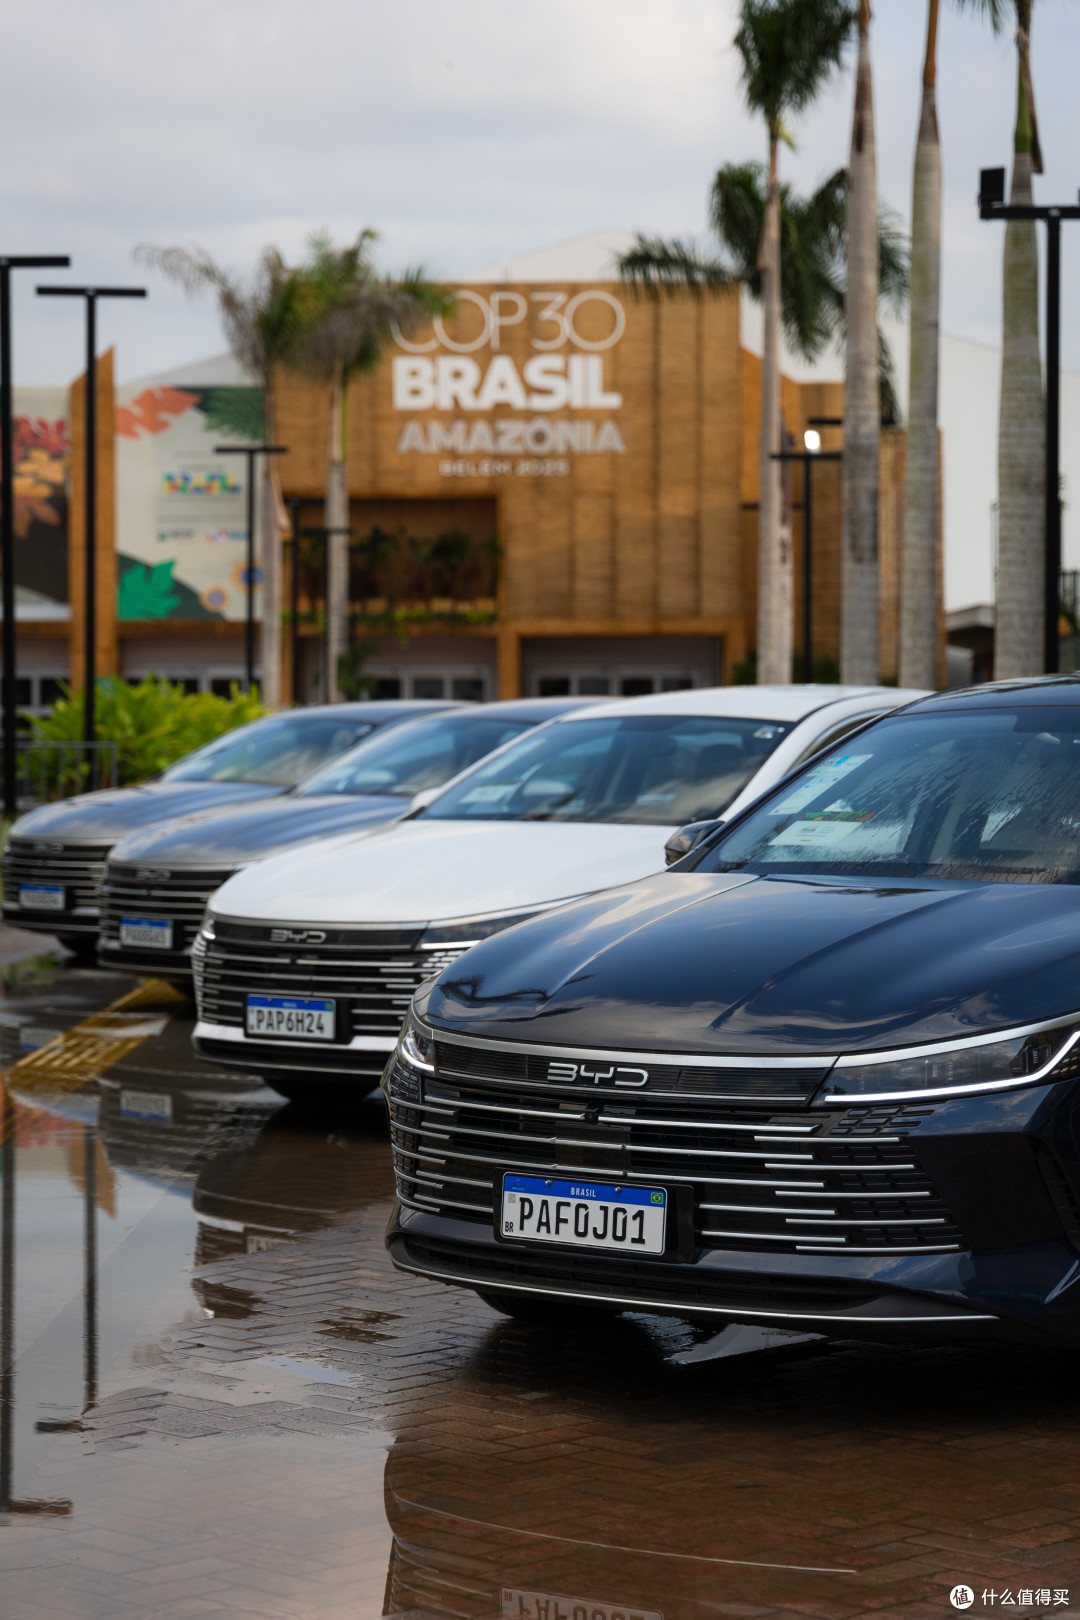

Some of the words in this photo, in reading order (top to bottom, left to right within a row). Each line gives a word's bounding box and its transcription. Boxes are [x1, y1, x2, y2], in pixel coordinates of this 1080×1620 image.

[392, 354, 623, 412] BRASIL
[270, 928, 327, 943] BYD
[256, 1009, 325, 1034] PAP6H24
[546, 1062, 649, 1087] BYD
[570, 1186, 597, 1198] BRASIL
[504, 1221, 514, 1233] BR
[518, 1197, 646, 1245] PAF0J01
